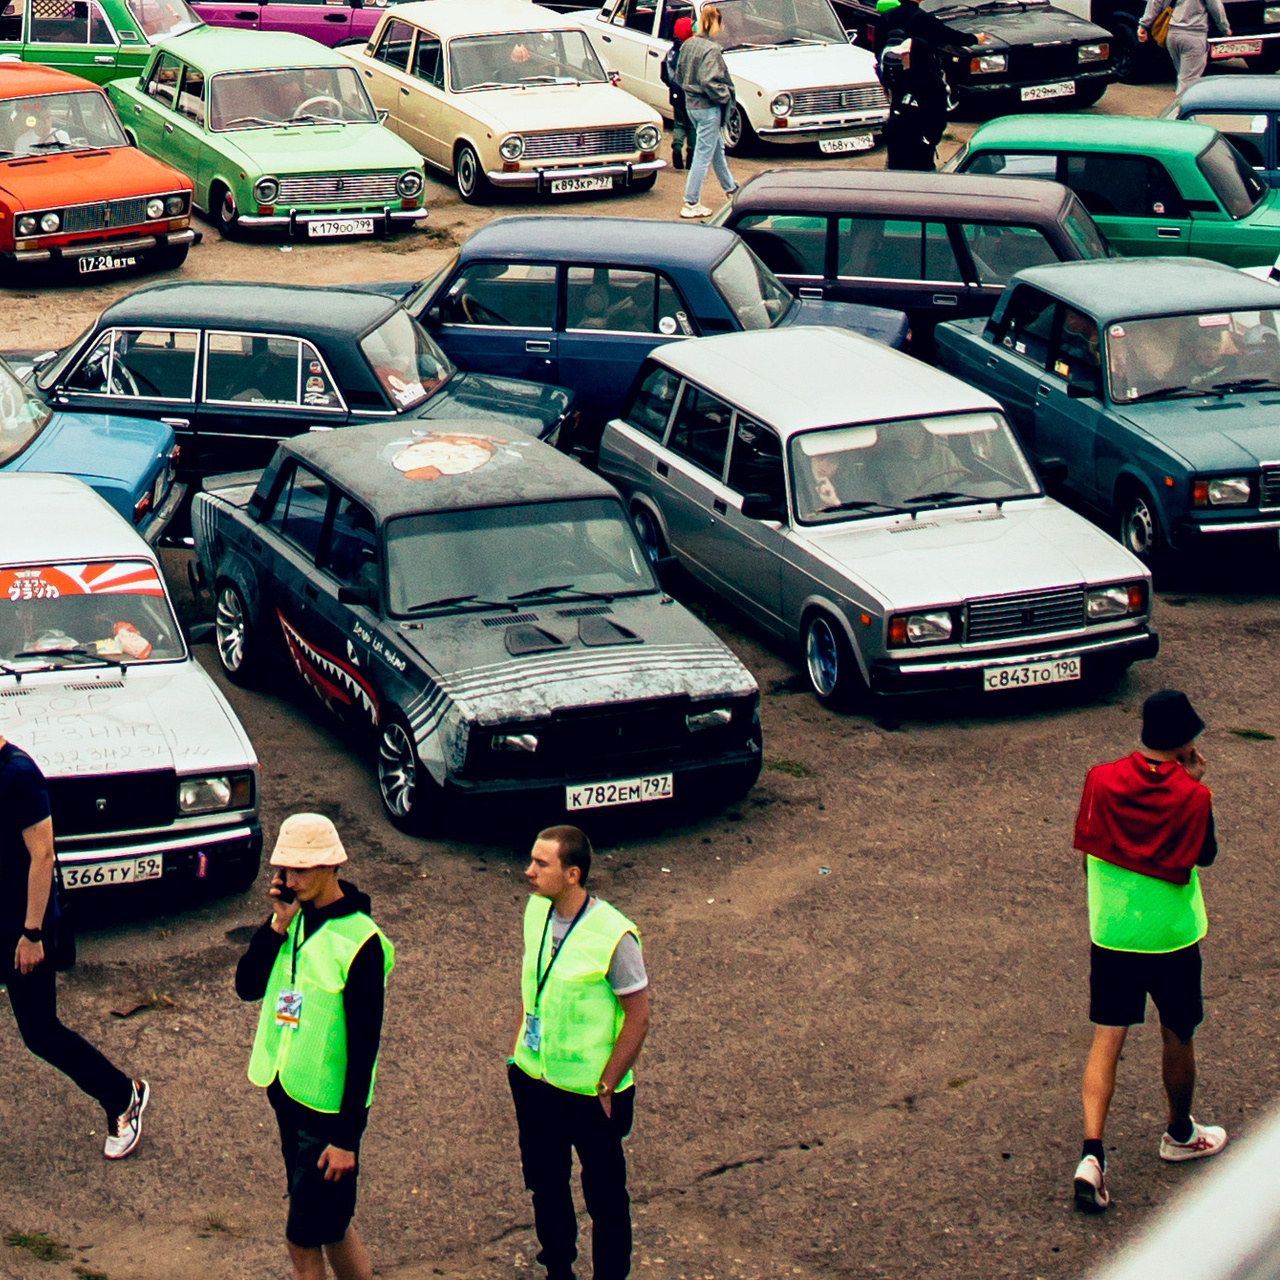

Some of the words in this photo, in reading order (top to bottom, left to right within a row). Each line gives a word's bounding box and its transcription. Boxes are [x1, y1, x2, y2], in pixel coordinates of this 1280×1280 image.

[595, 176, 609, 186] 797
[354, 220, 371, 229] 799
[988, 669, 1051, 688] С843ТО
[1054, 660, 1076, 675] 190
[572, 784, 640, 808] К782ЕМ
[642, 776, 668, 794] 797
[66, 866, 131, 887] 366ТУ
[137, 858, 156, 875] 59
